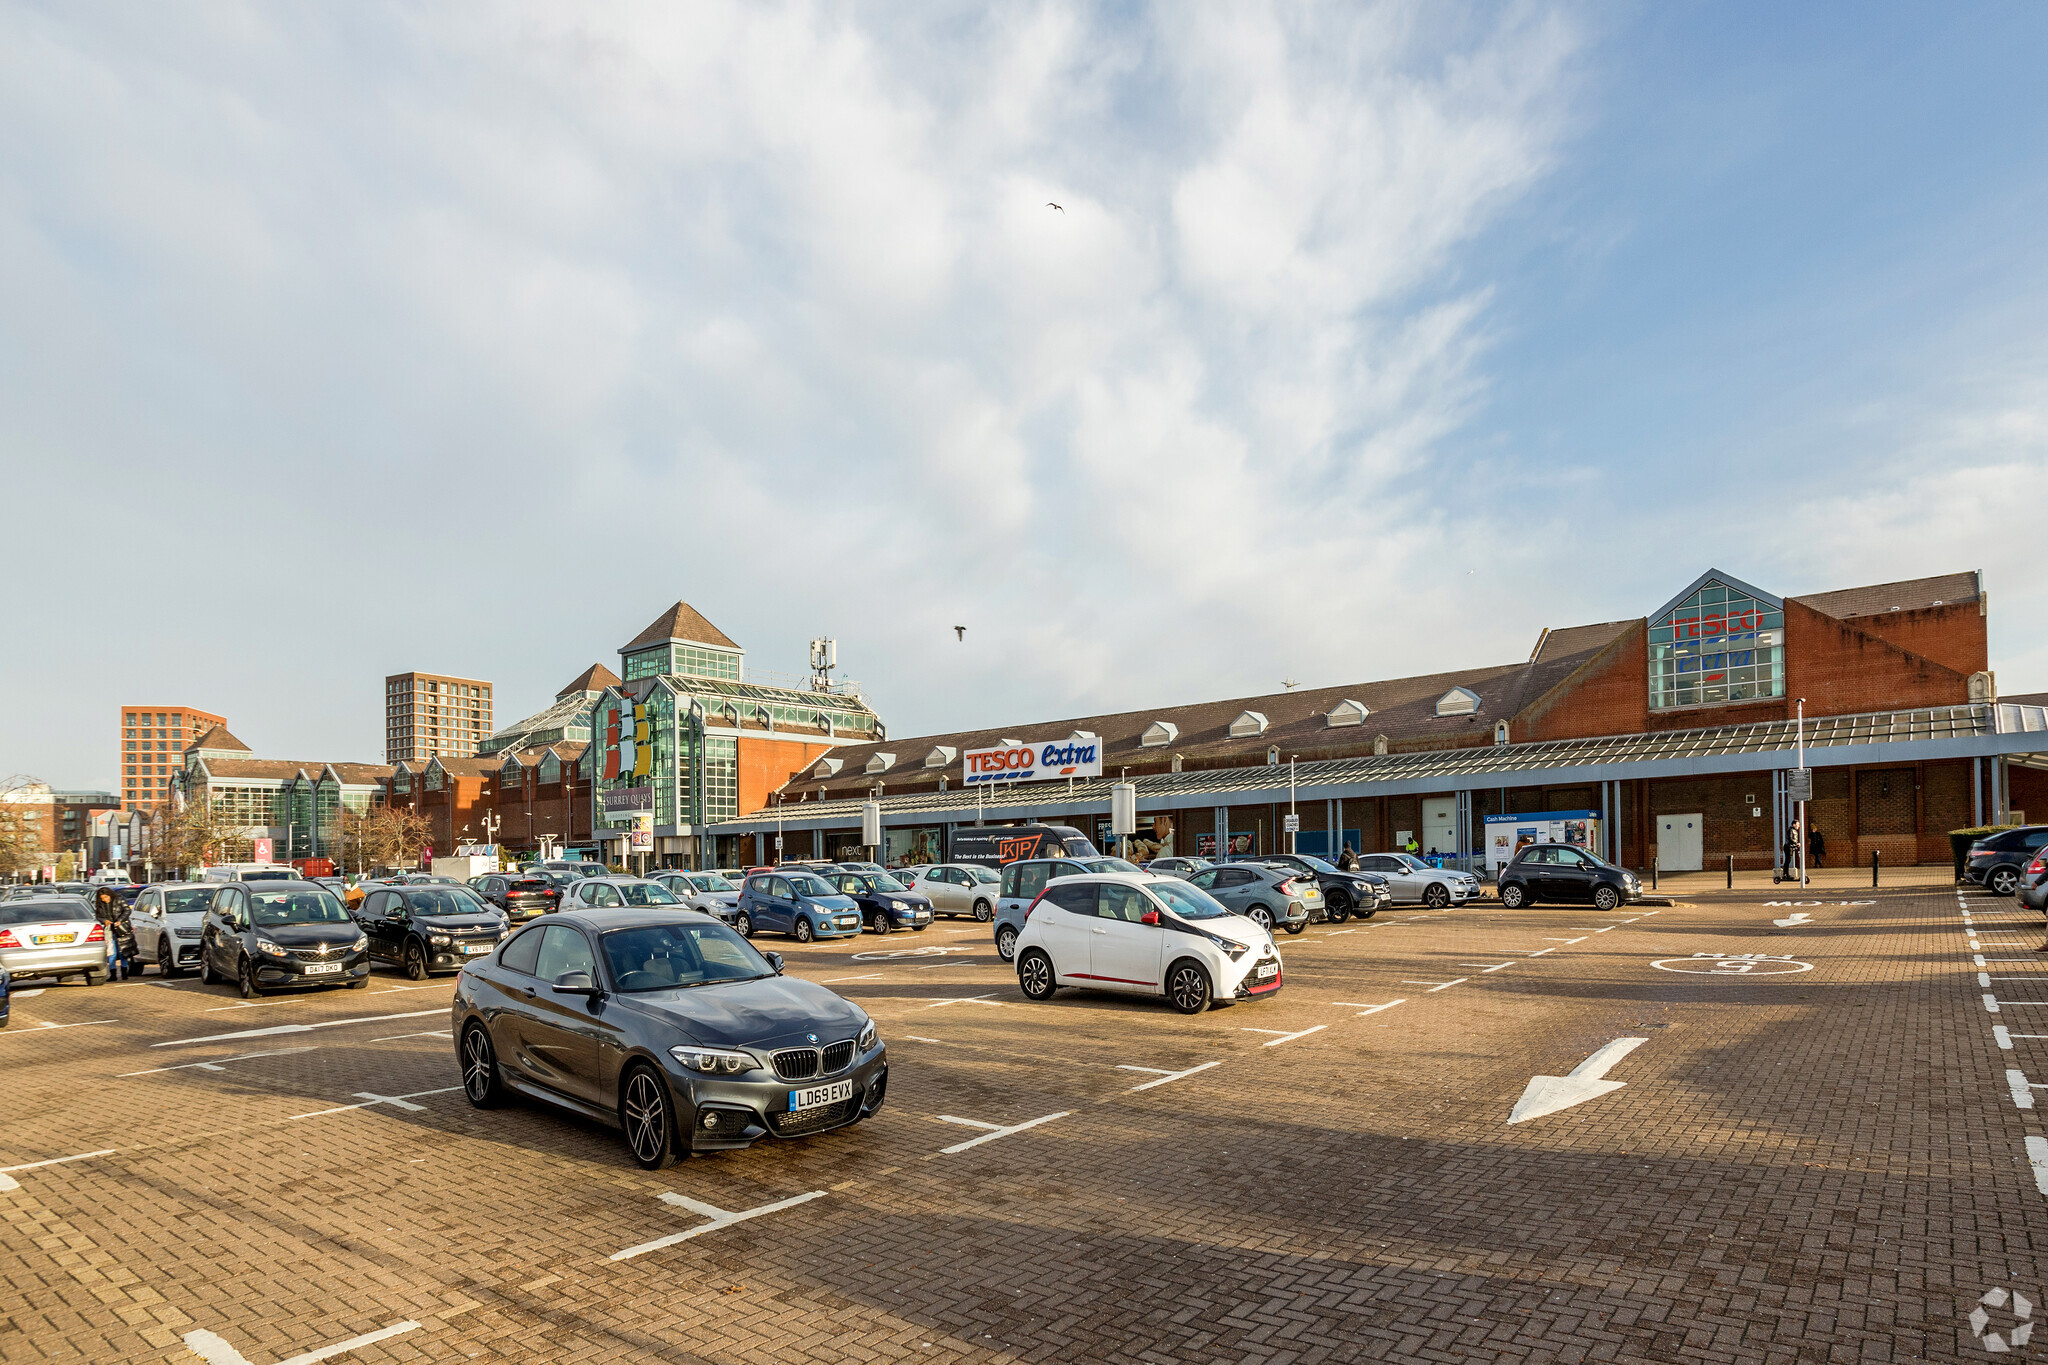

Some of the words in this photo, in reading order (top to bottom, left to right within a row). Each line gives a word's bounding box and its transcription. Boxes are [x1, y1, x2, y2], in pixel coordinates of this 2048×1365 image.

[1668, 608, 1763, 638] TESCO
[1679, 650, 1751, 673] extra
[966, 748, 1035, 772] TESCO
[1041, 743, 1096, 767] extra
[606, 795, 630, 806] SURREY
[630, 793, 651, 806] QUAYS
[841, 845, 862, 856] next
[1710, 961, 1758, 973] 5
[798, 1088, 829, 1107] LD69
[831, 1082, 851, 1100] EVX
